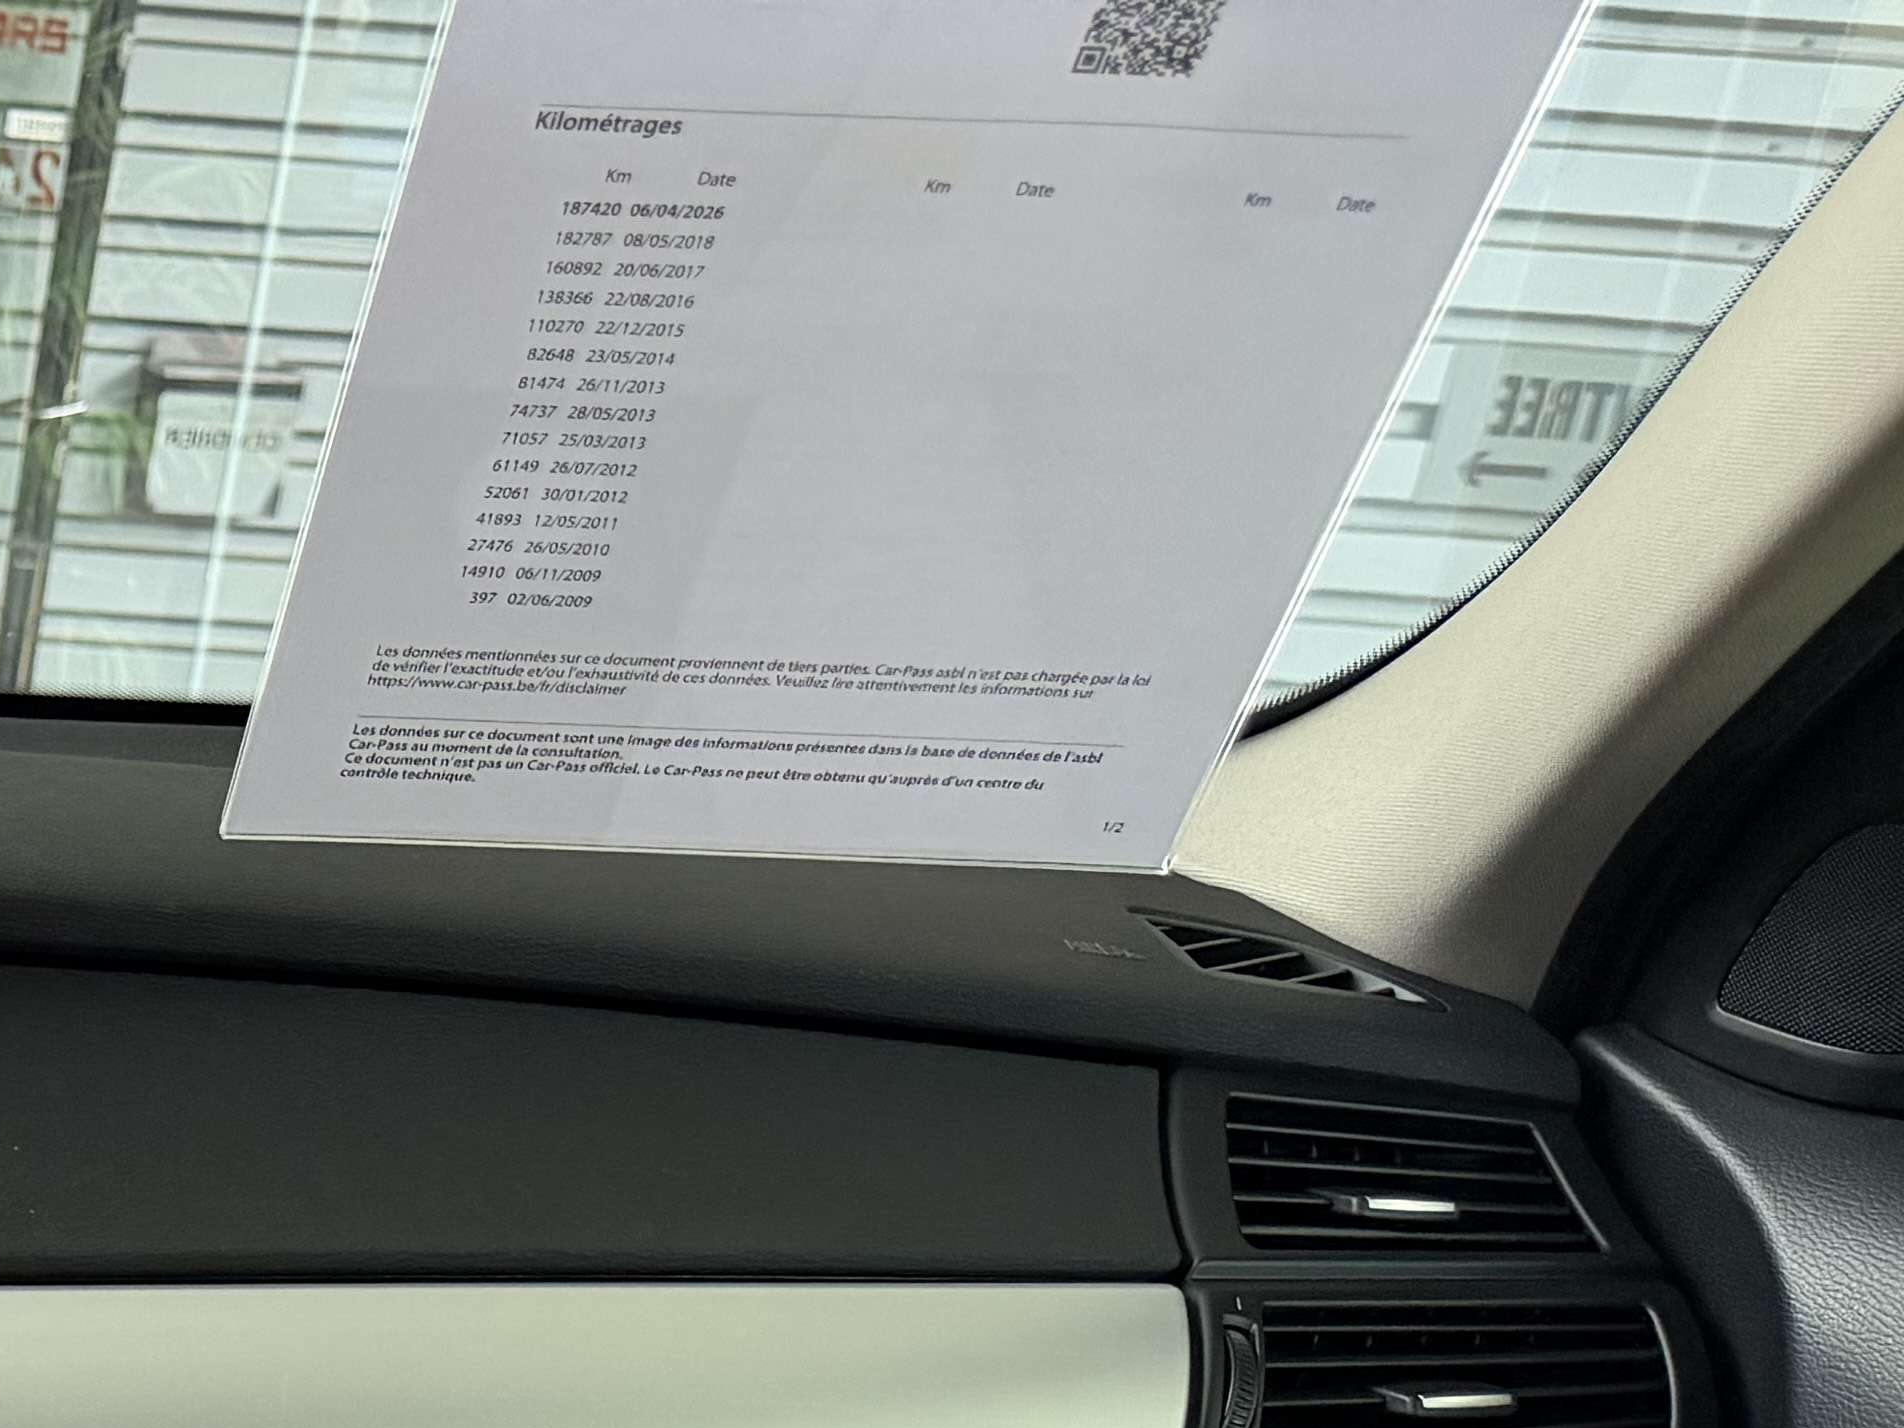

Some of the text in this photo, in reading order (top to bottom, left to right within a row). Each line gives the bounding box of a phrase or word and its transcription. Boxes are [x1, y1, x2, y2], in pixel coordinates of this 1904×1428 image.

[536, 111, 683, 138] Kilométrages
[605, 168, 1376, 213] Km Date Km Date Km Date
[563, 201, 725, 219] 187420 06/04/2026
[556, 231, 715, 250] 182787 08/05/2018
[547, 261, 705, 279] 160892 20/06/2017
[538, 290, 694, 308] 138366 22/08/2016
[530, 318, 685, 337] 110270 22/12/2015
[527, 348, 675, 366] 82648 23/05/2014
[518, 376, 665, 394] 81474 26/11/2013
[510, 404, 656, 422] 74737 28/05/2013
[502, 432, 646, 450] 71057 25/03/2013
[493, 459, 637, 477] 61149 26/07/2012
[484, 486, 628, 504] 52061 30/01/2012
[476, 512, 618, 530] 41893 12/05/2011
[467, 539, 610, 556] 27476 26/05/2010
[462, 566, 602, 582] 14910 06/11/2009
[469, 592, 592, 608] 397 02/06/2009
[349, 738, 623, 762] Car-Pass au moment de la consultation.
[352, 724, 1103, 764] Les données sur ce document sont une image des informations présentes dans la base de données de l'asbl
[340, 768, 479, 784] contrôle technique.
[345, 752, 1044, 790] Ce document n'est pas un Car-Pass officiel. Le Car-Pass ne peut être obtenu qu'auprès d'un centre du
[1103, 822, 1124, 833] 1/2
